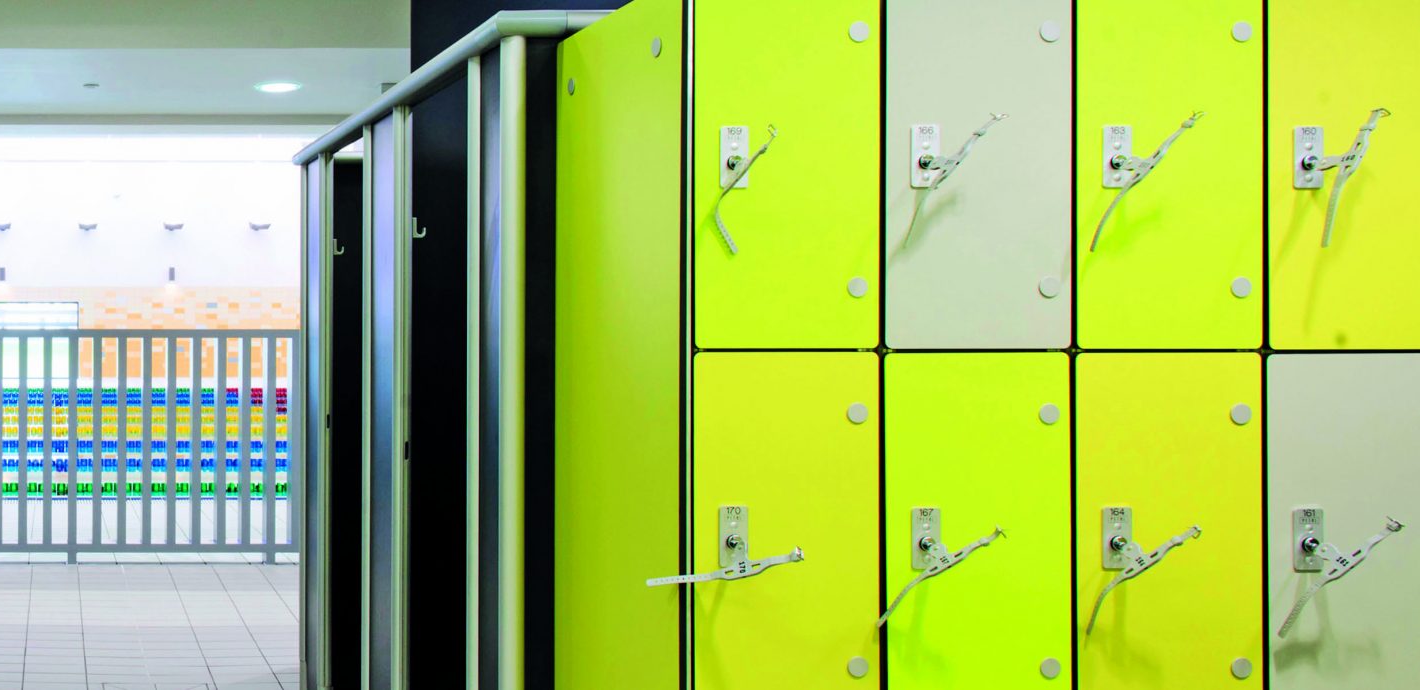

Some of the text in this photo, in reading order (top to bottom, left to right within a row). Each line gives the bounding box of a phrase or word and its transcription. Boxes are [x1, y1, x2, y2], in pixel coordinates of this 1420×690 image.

[727, 127, 742, 135] 169
[918, 127, 934, 135] 166
[1110, 127, 1125, 135] 163
[1301, 127, 1317, 135] 160
[726, 506, 741, 515] 170
[919, 508, 934, 516] 167
[1109, 508, 1125, 516] 164
[1302, 509, 1316, 517] 161
